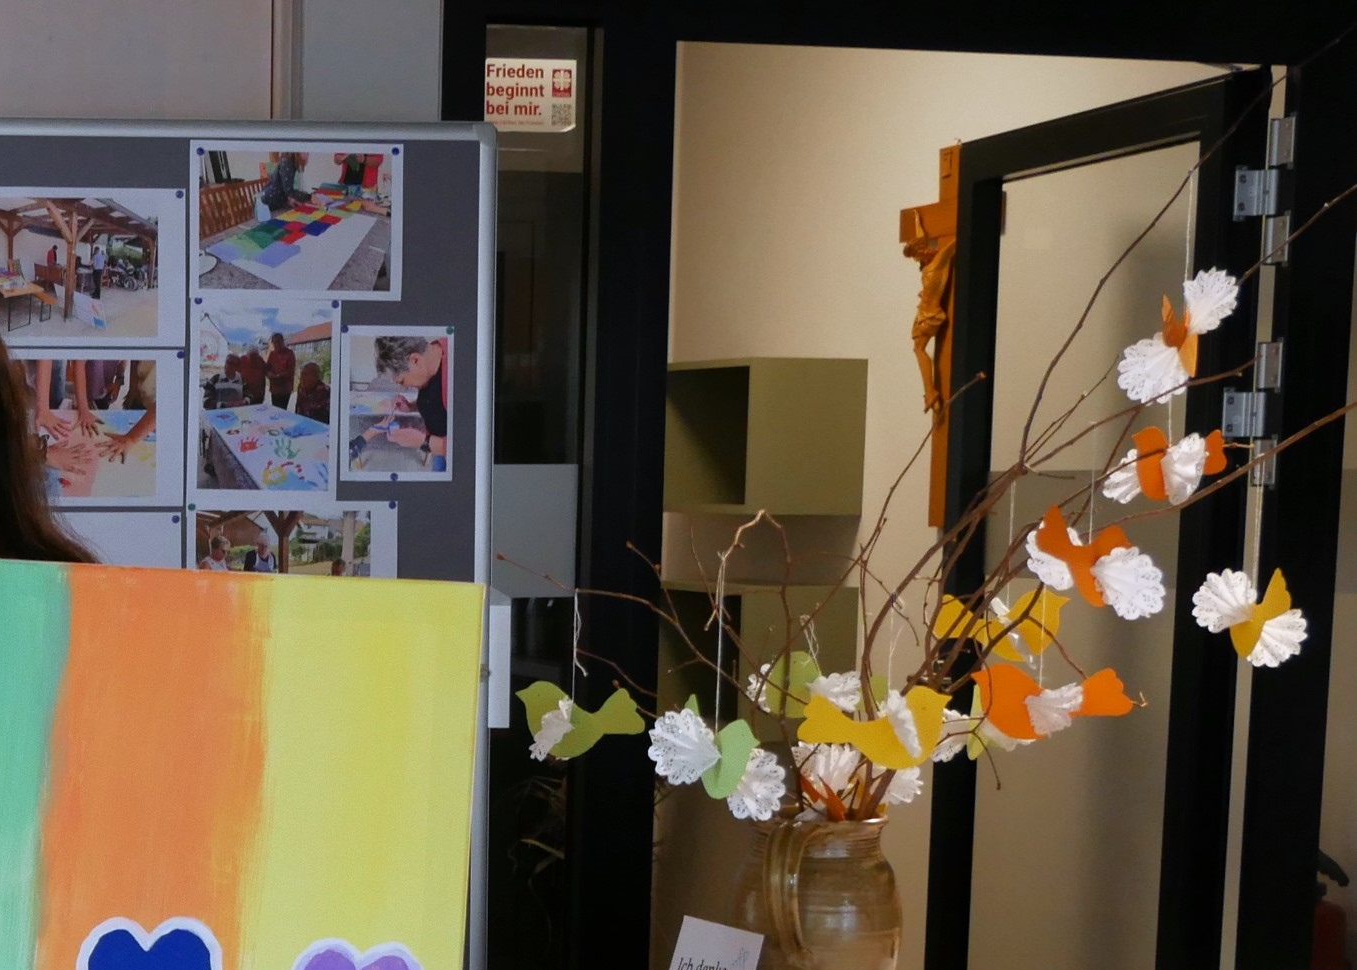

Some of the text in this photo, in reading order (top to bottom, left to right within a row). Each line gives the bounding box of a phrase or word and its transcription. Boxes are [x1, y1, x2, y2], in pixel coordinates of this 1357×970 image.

[486, 63, 544, 79] Frieden
[486, 82, 545, 101] beginnt
[485, 101, 542, 116] bei mir.
